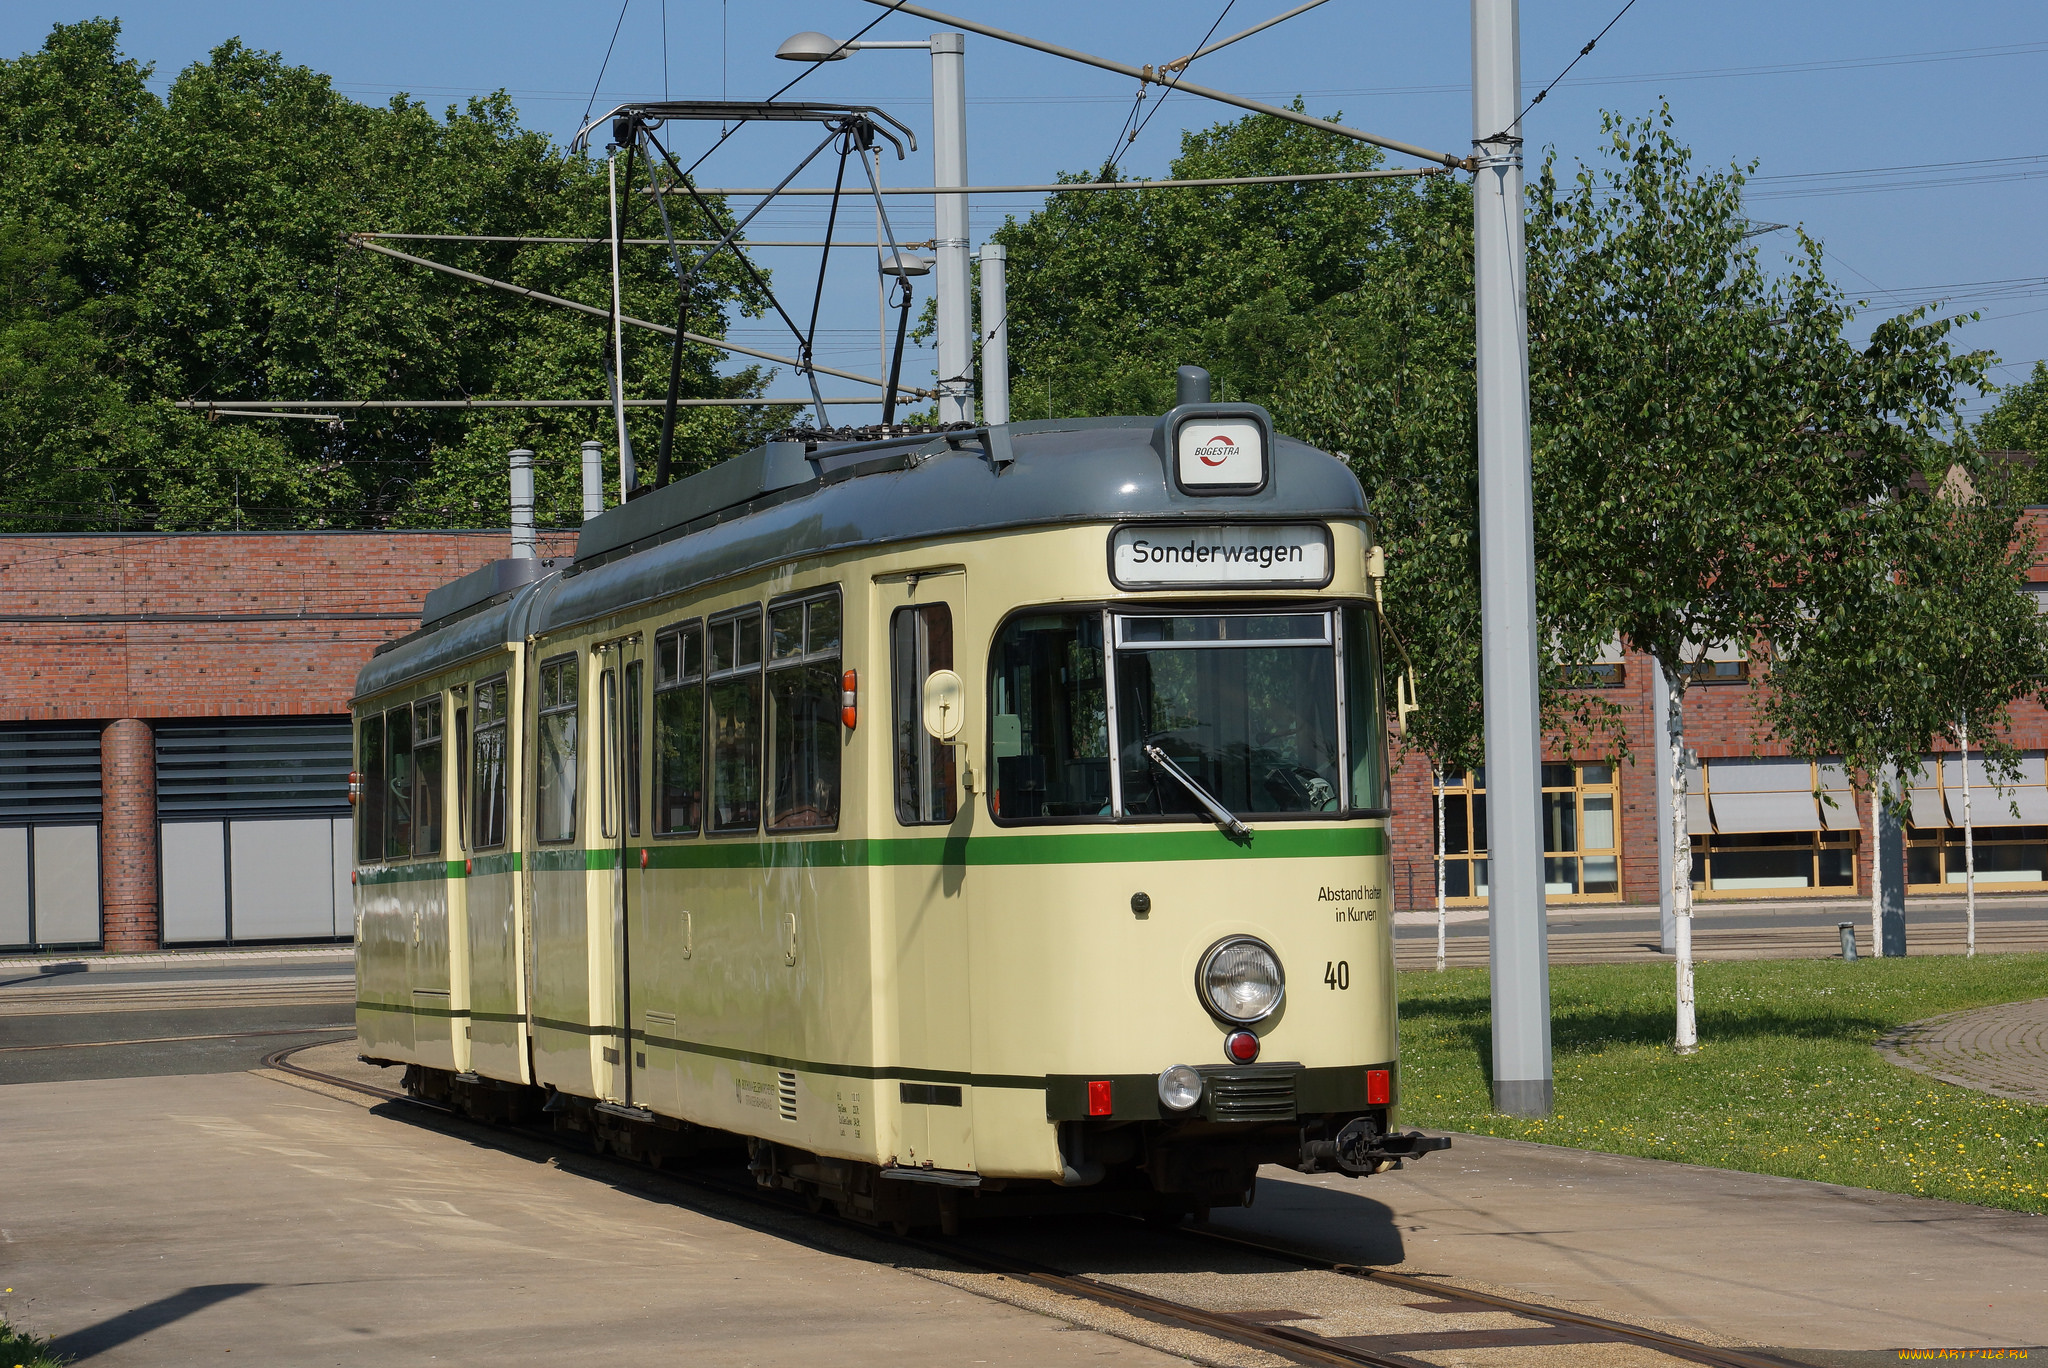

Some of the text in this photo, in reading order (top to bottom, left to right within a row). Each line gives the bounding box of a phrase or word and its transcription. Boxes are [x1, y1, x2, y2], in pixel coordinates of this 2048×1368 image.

[1194, 446, 1240, 456] BOGESTRA
[1132, 539, 1303, 568] Sonderwagen
[1317, 885, 1363, 902] Abstand
[1335, 906, 1377, 922] in Kurven
[1323, 960, 1350, 991] 40
